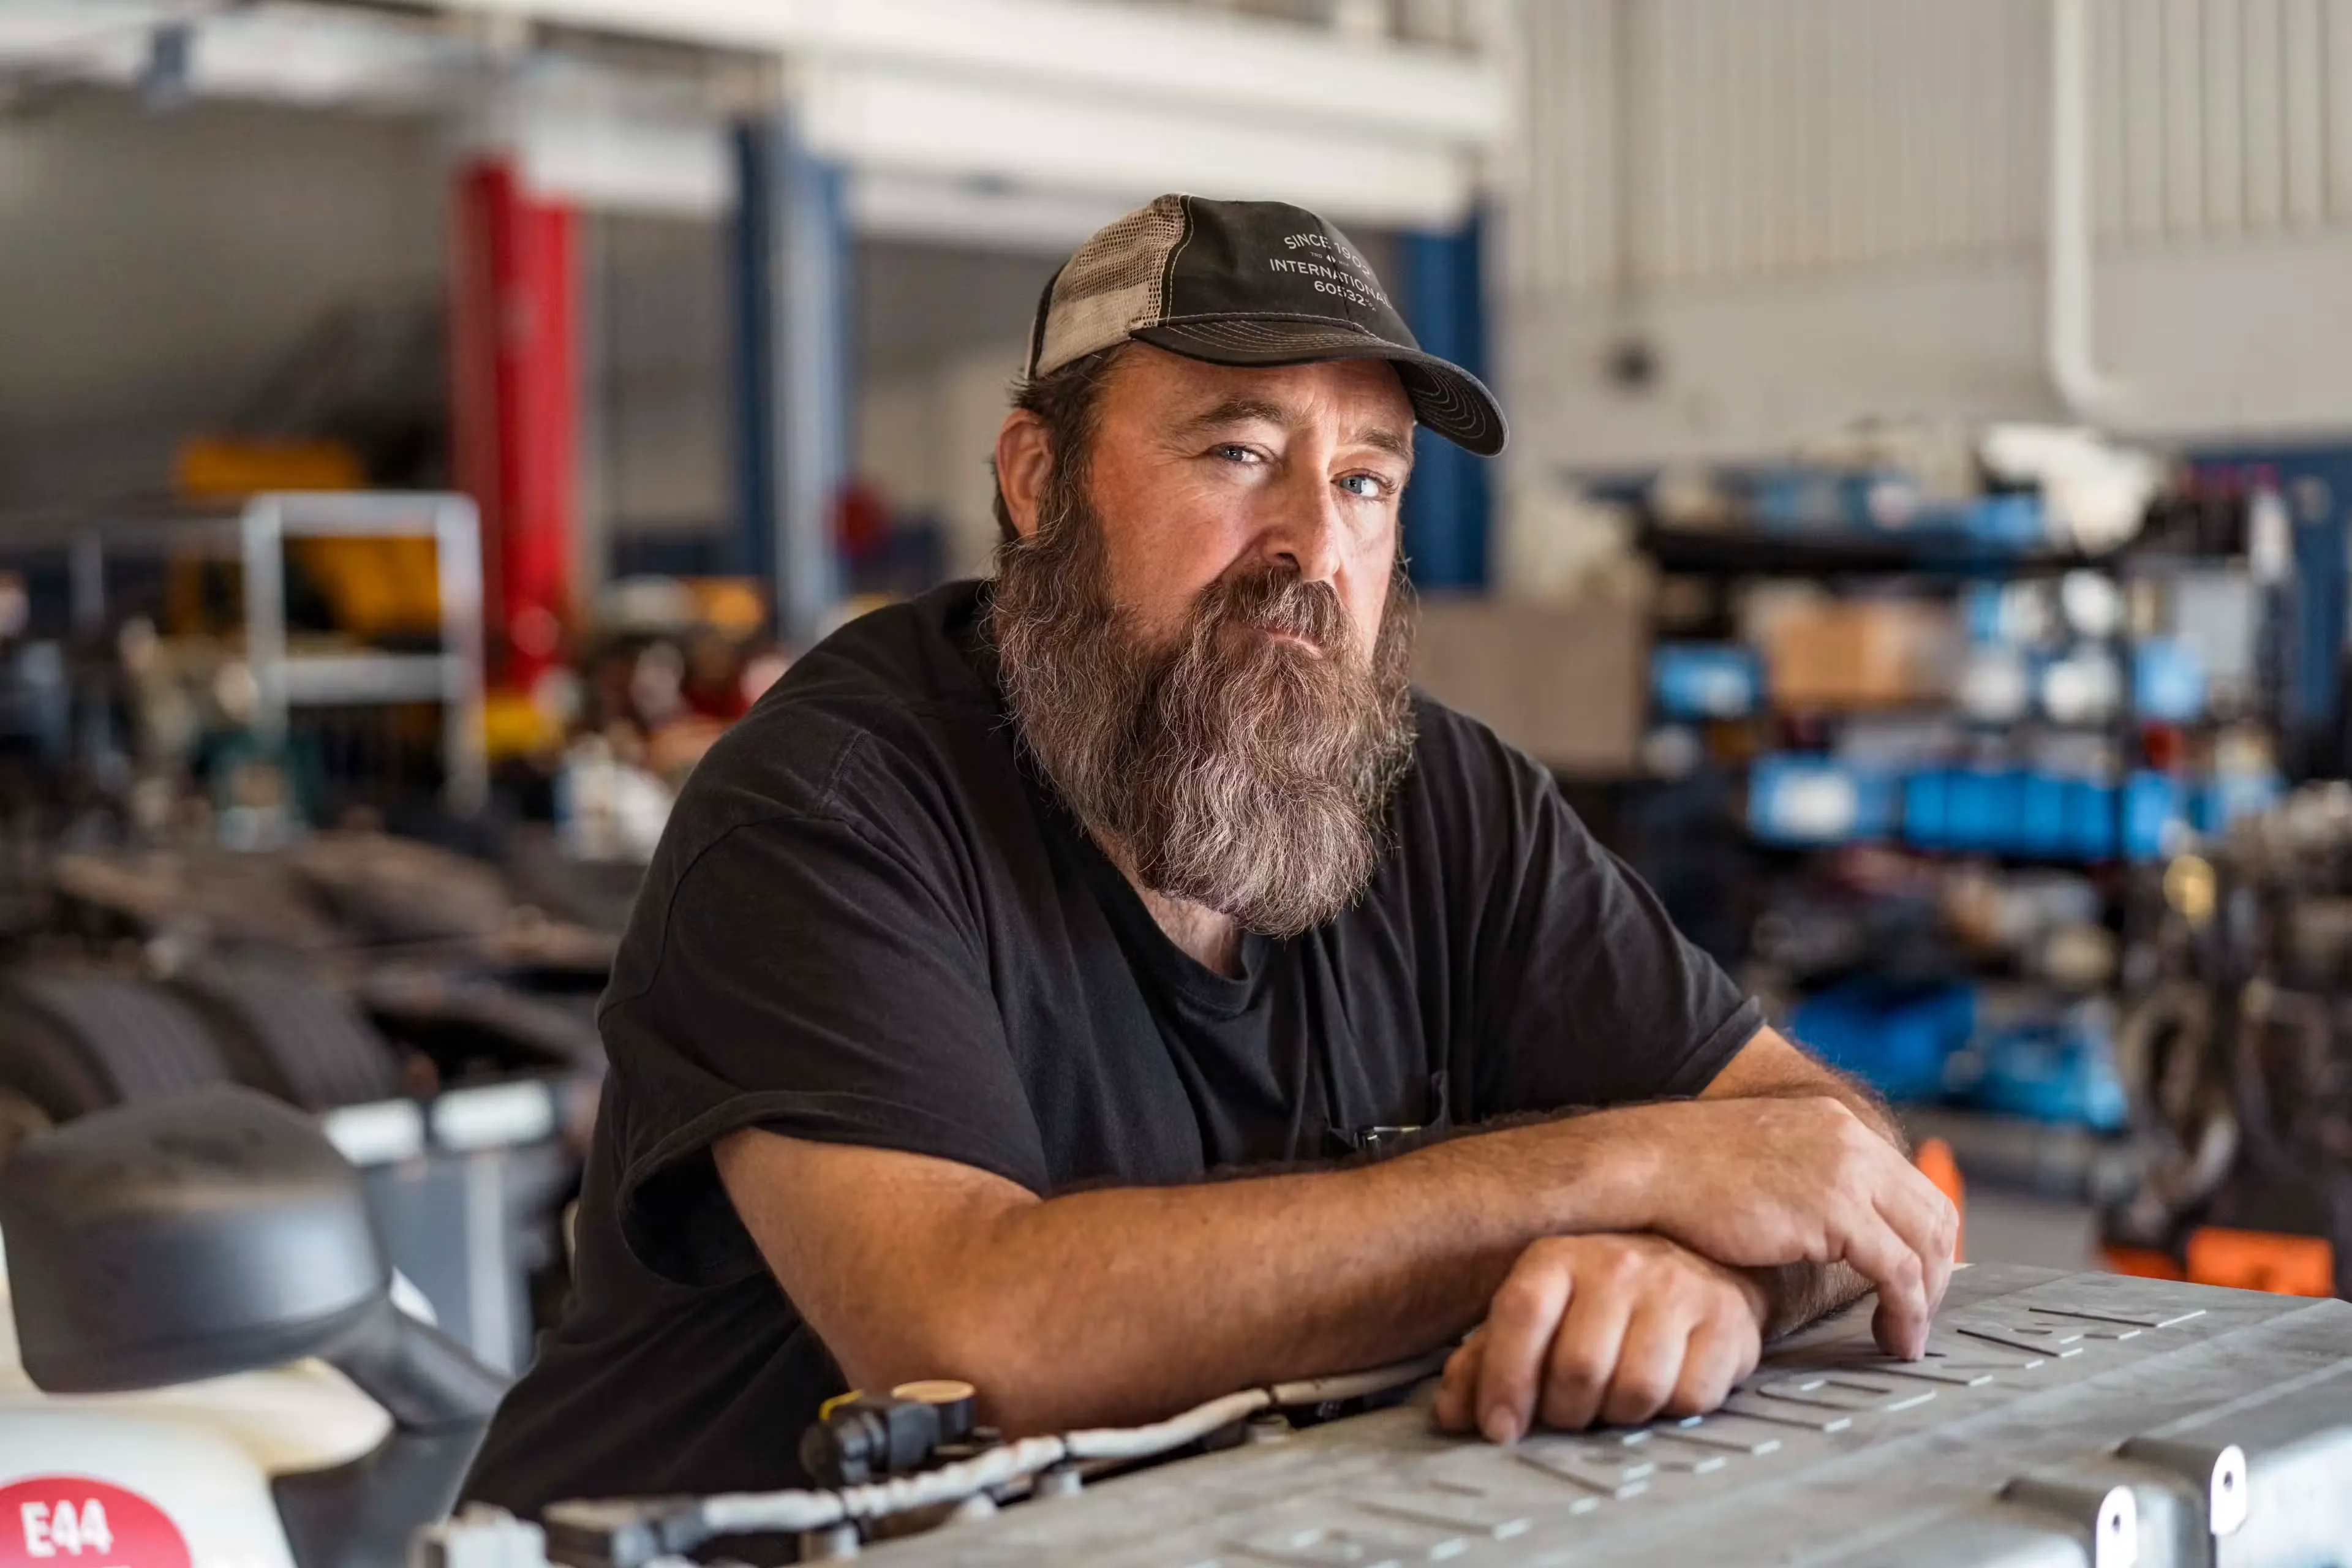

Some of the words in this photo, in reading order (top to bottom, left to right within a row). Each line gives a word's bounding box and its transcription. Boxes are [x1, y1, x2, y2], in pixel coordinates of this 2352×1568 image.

[1284, 233, 1332, 249] SINCE
[1269, 258, 1393, 309] INTERNATIONAL
[1314, 281, 1366, 306] 60532
[21, 1498, 114, 1557] E44
